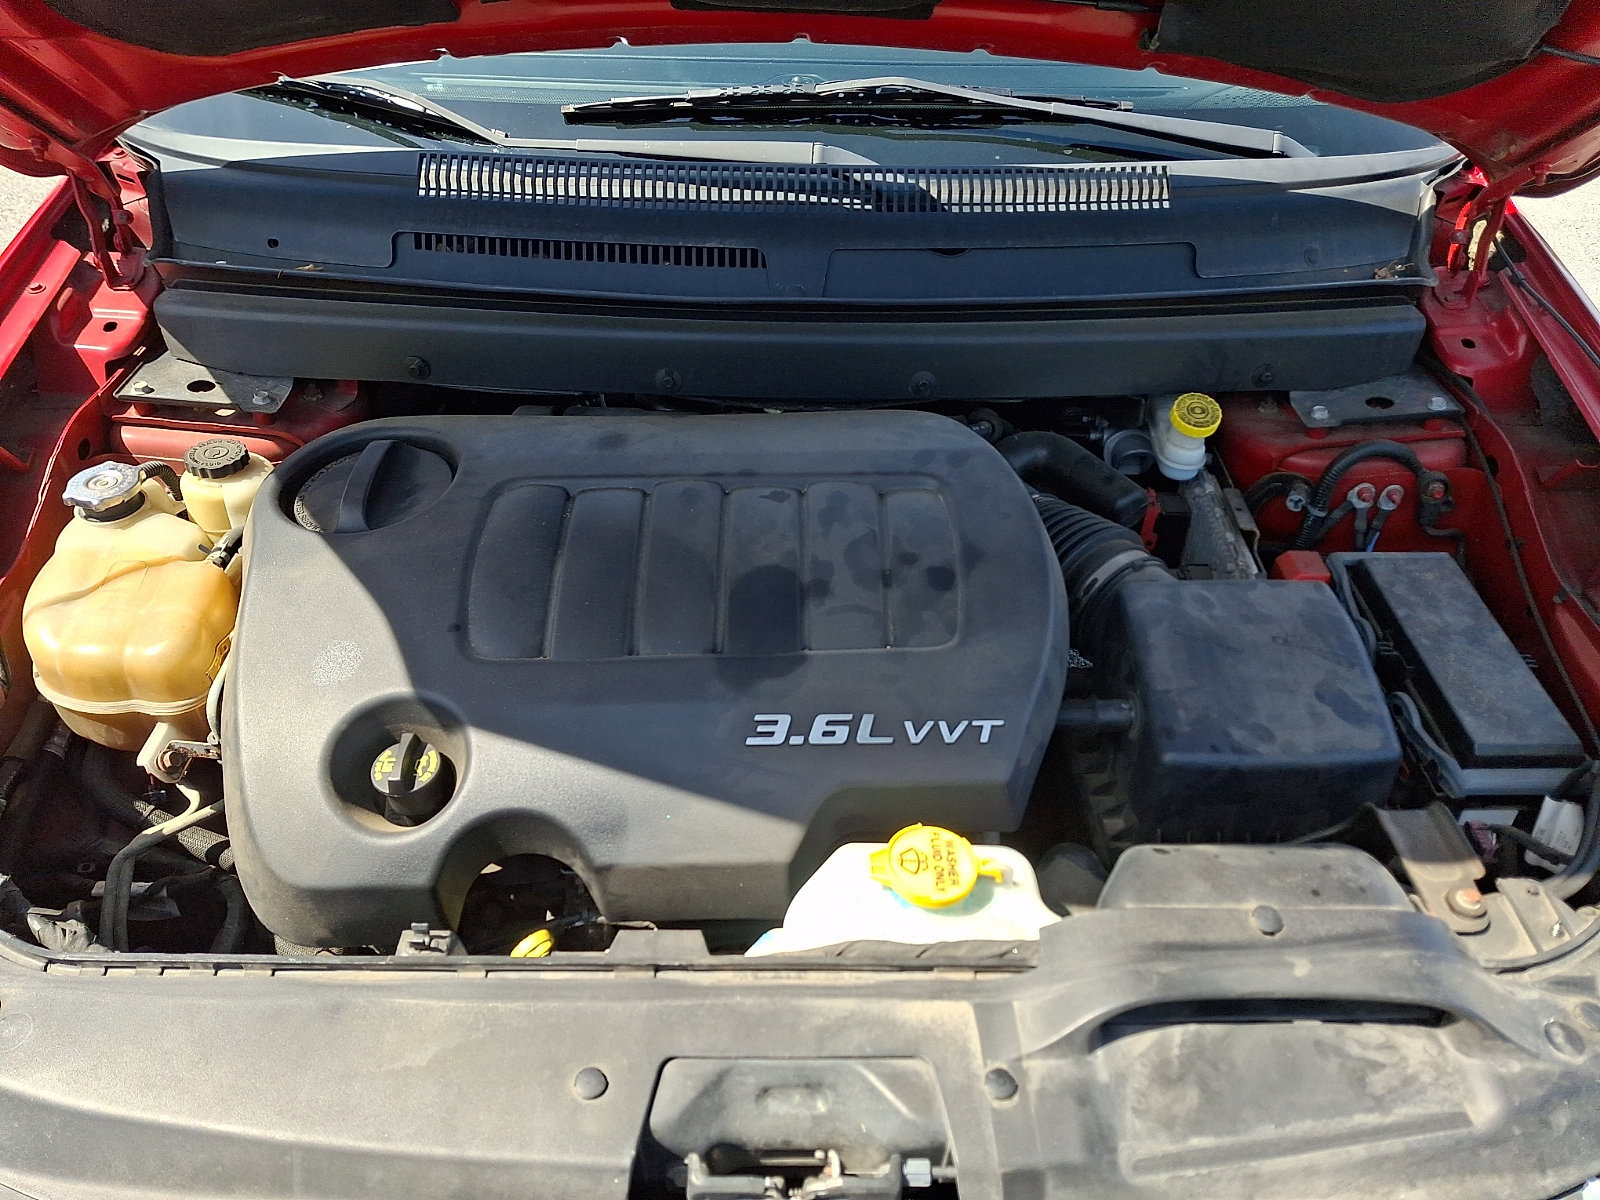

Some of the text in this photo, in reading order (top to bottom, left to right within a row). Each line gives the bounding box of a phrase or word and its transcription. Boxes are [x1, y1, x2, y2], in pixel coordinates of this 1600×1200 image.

[745, 713, 1006, 746] 3.6L VVT
[930, 831, 946, 892] FLUID ONLY
[945, 839, 960, 887] WASHER
